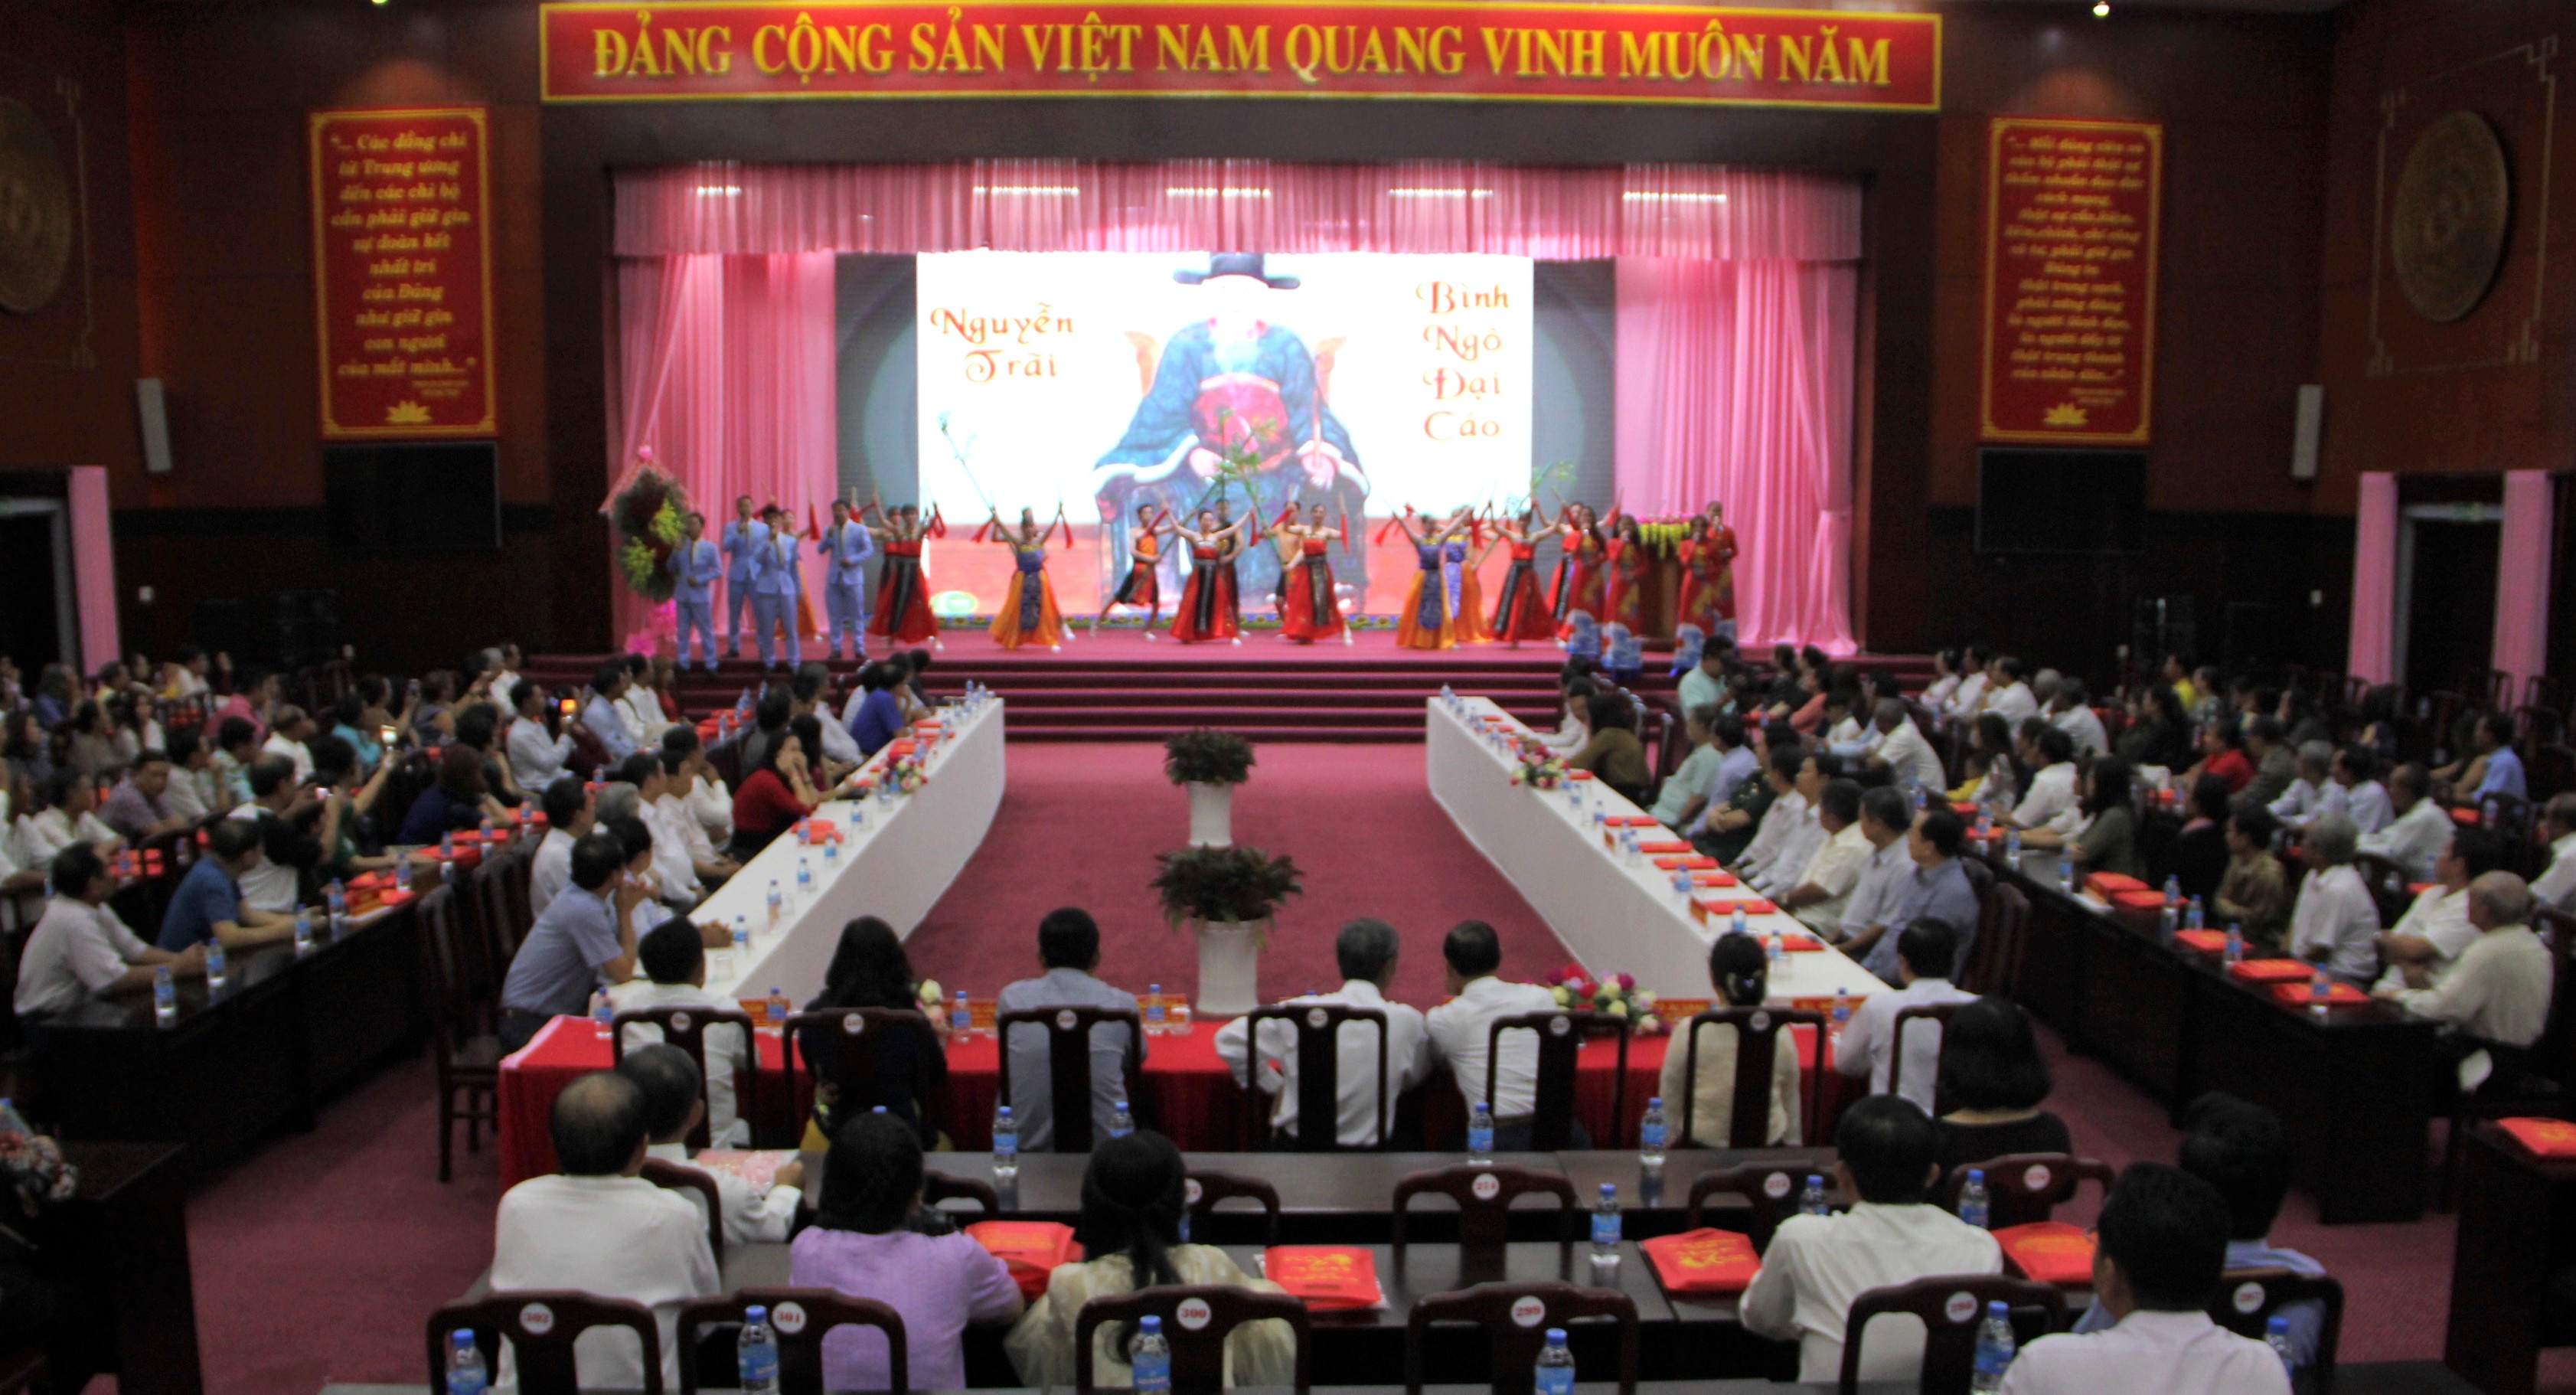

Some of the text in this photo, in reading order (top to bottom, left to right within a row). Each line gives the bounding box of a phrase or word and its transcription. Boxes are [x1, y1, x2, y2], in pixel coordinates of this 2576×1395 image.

[593, 5, 1892, 87] ĐẢNG CỘNG SẢN VIỆT NAM QUANG VINH MUÔN NĂM
[1415, 280, 1510, 315] Bình
[929, 302, 1074, 346] Nguyễn
[1423, 325, 1503, 362] Ngô
[965, 348, 1057, 384] Trãi
[1423, 366, 1501, 403] Đại
[1423, 410, 1501, 443] Cáo
[778, 1311, 802, 1324] 301
[1181, 1307, 1207, 1319] 300
